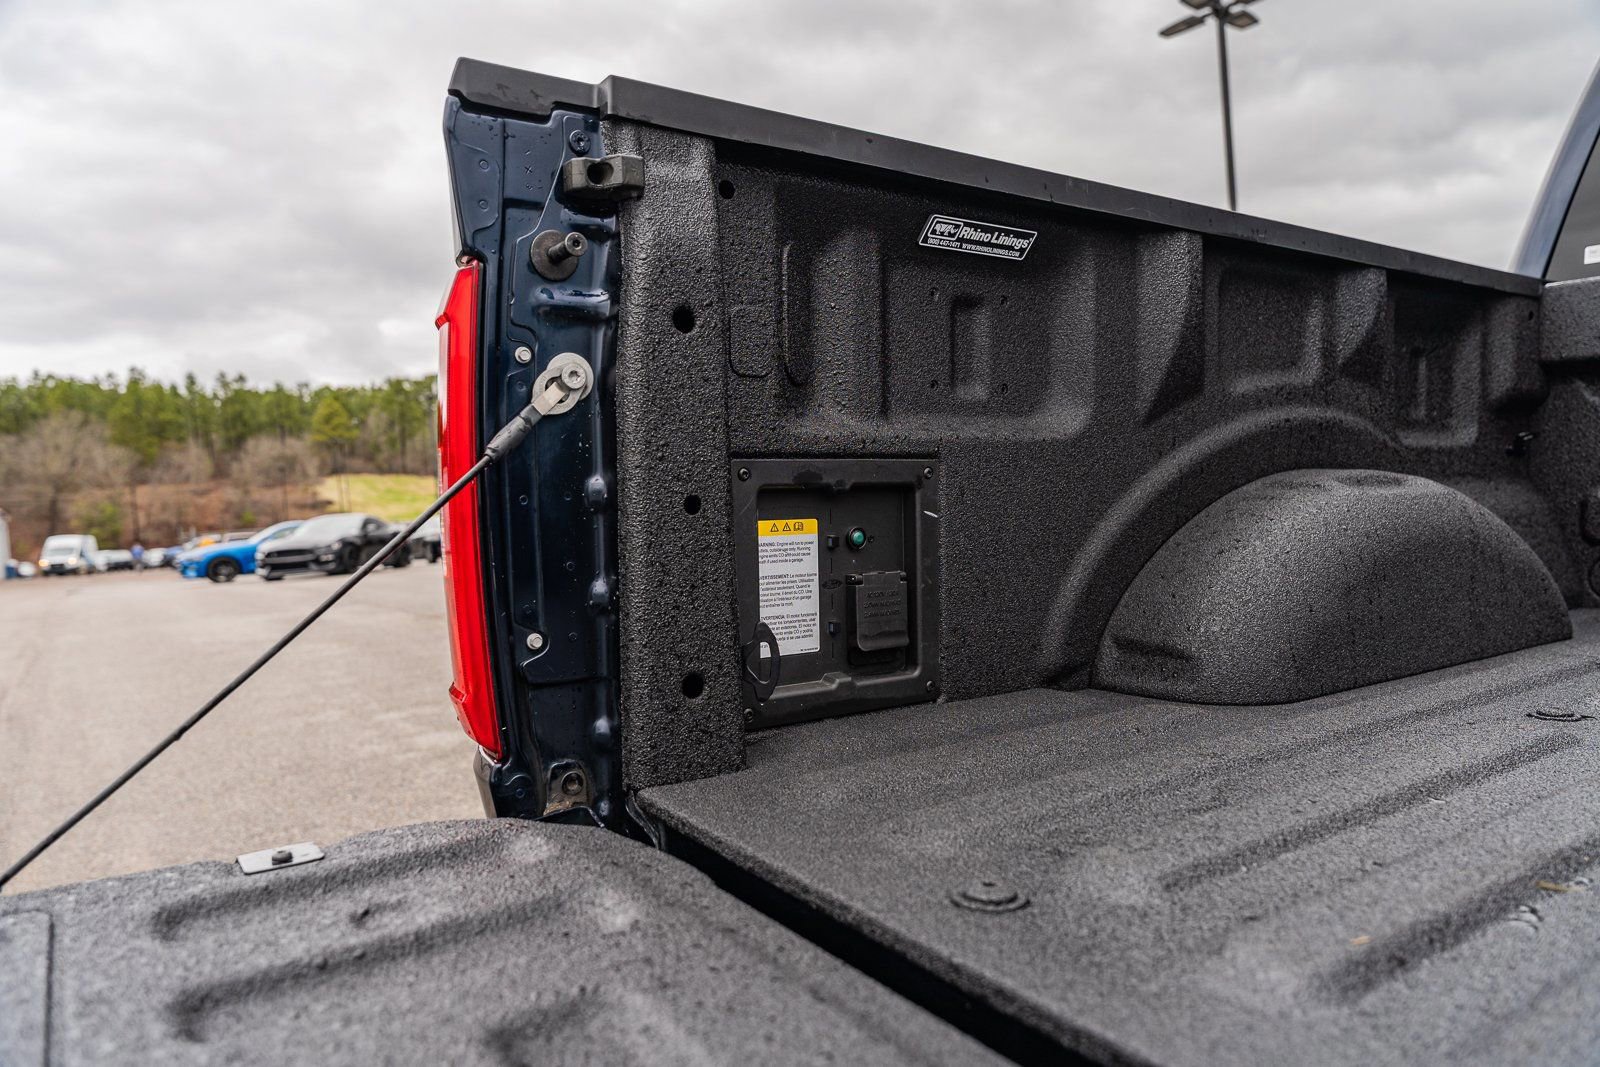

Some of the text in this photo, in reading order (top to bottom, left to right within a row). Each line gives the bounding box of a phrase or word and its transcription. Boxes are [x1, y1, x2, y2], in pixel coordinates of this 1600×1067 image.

[927, 237, 940, 246] (800)
[962, 243, 1021, 257] WWW.RHINOLININGS.COM
[959, 226, 1030, 250] Rhino Linings
